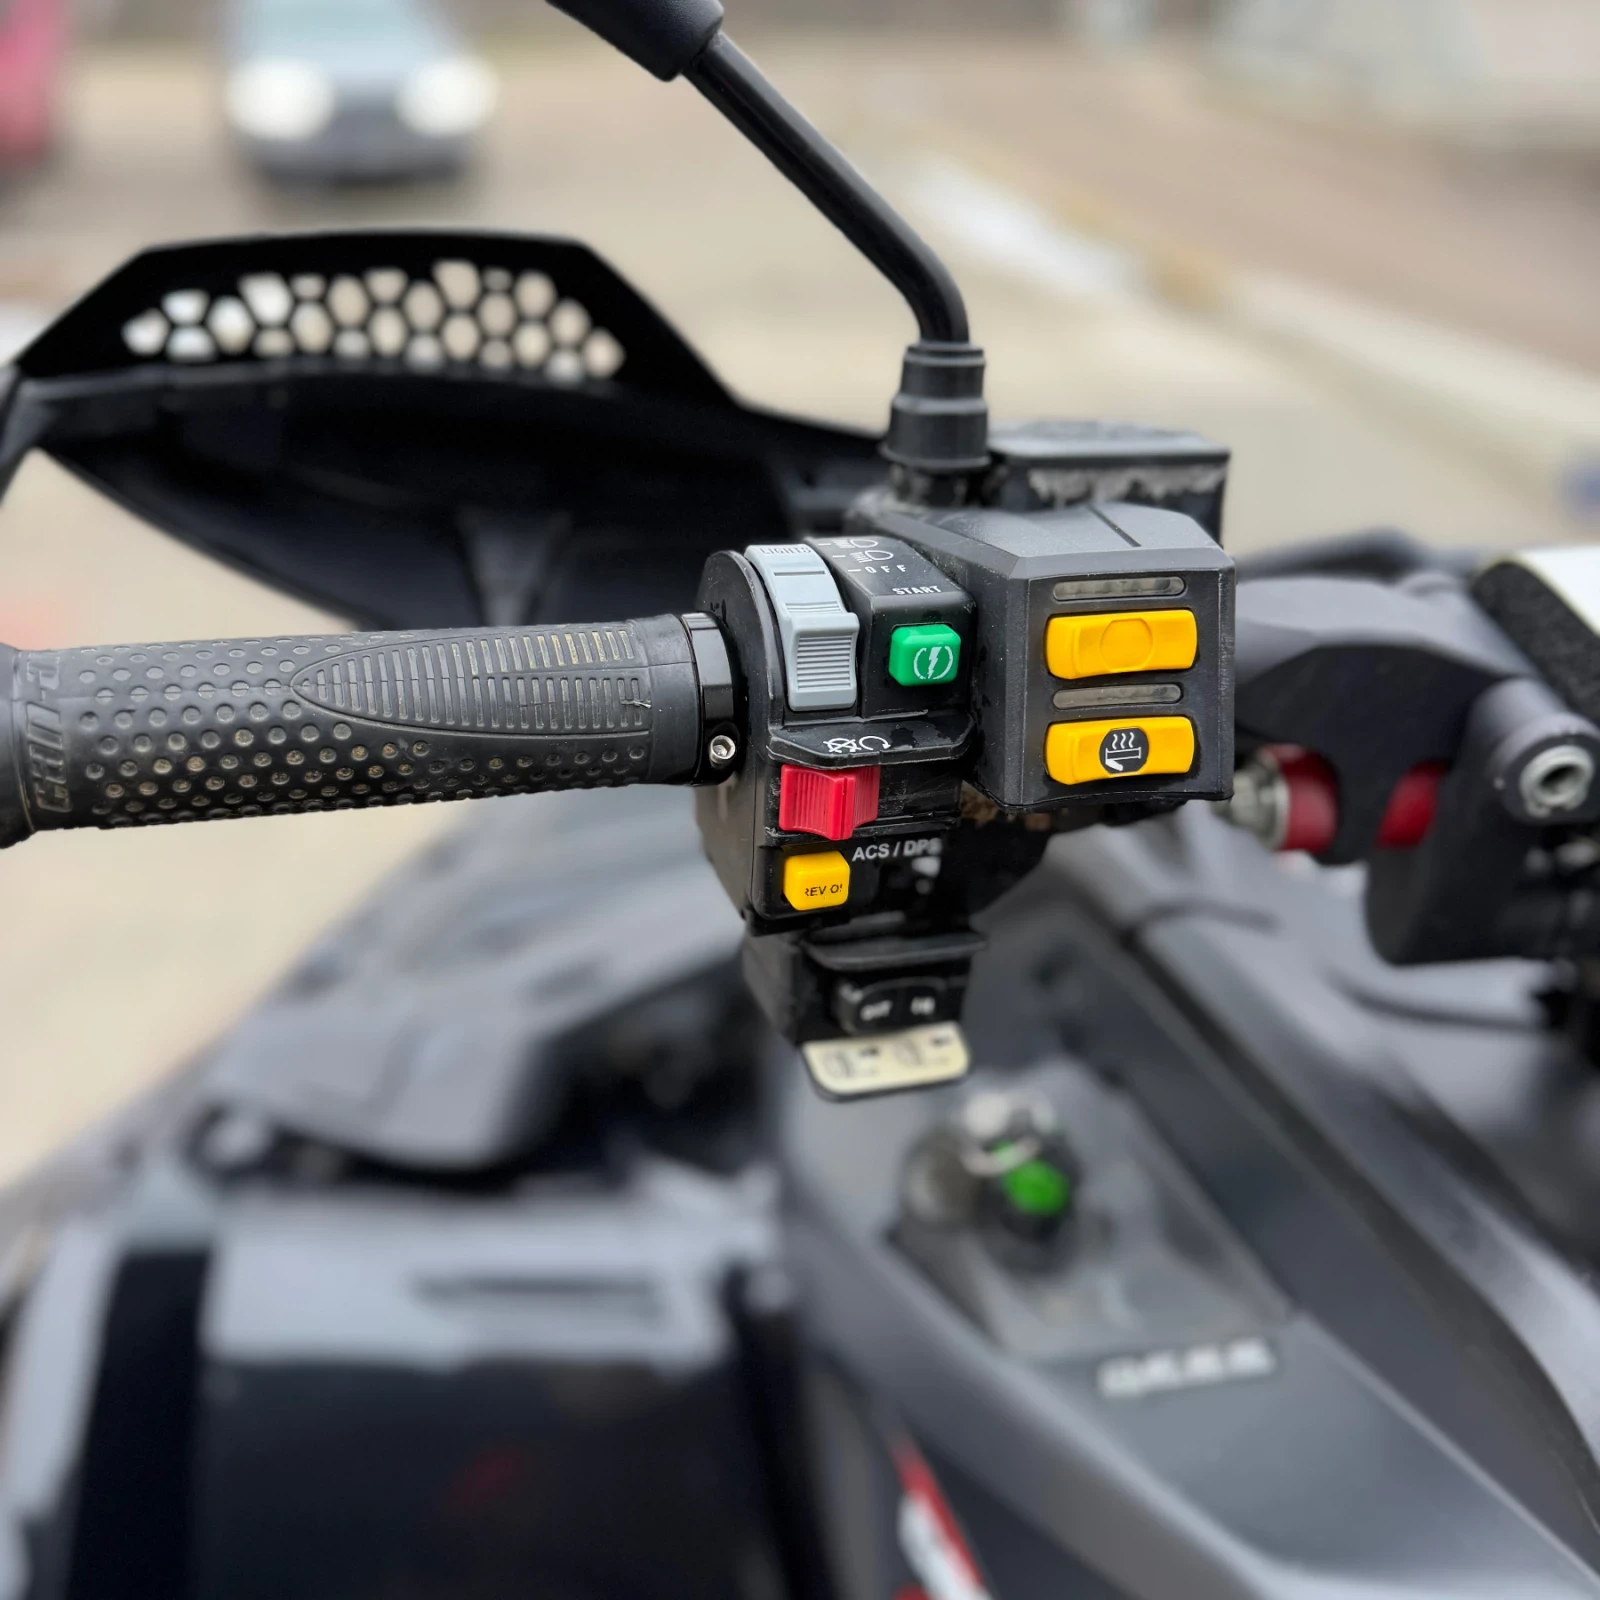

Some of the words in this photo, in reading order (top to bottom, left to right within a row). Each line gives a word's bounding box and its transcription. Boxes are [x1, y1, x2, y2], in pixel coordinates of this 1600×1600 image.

[760, 547, 811, 555] LIGHTS
[865, 564, 907, 574] OFF
[892, 585, 942, 595] START
[852, 843, 890, 861] ACS
